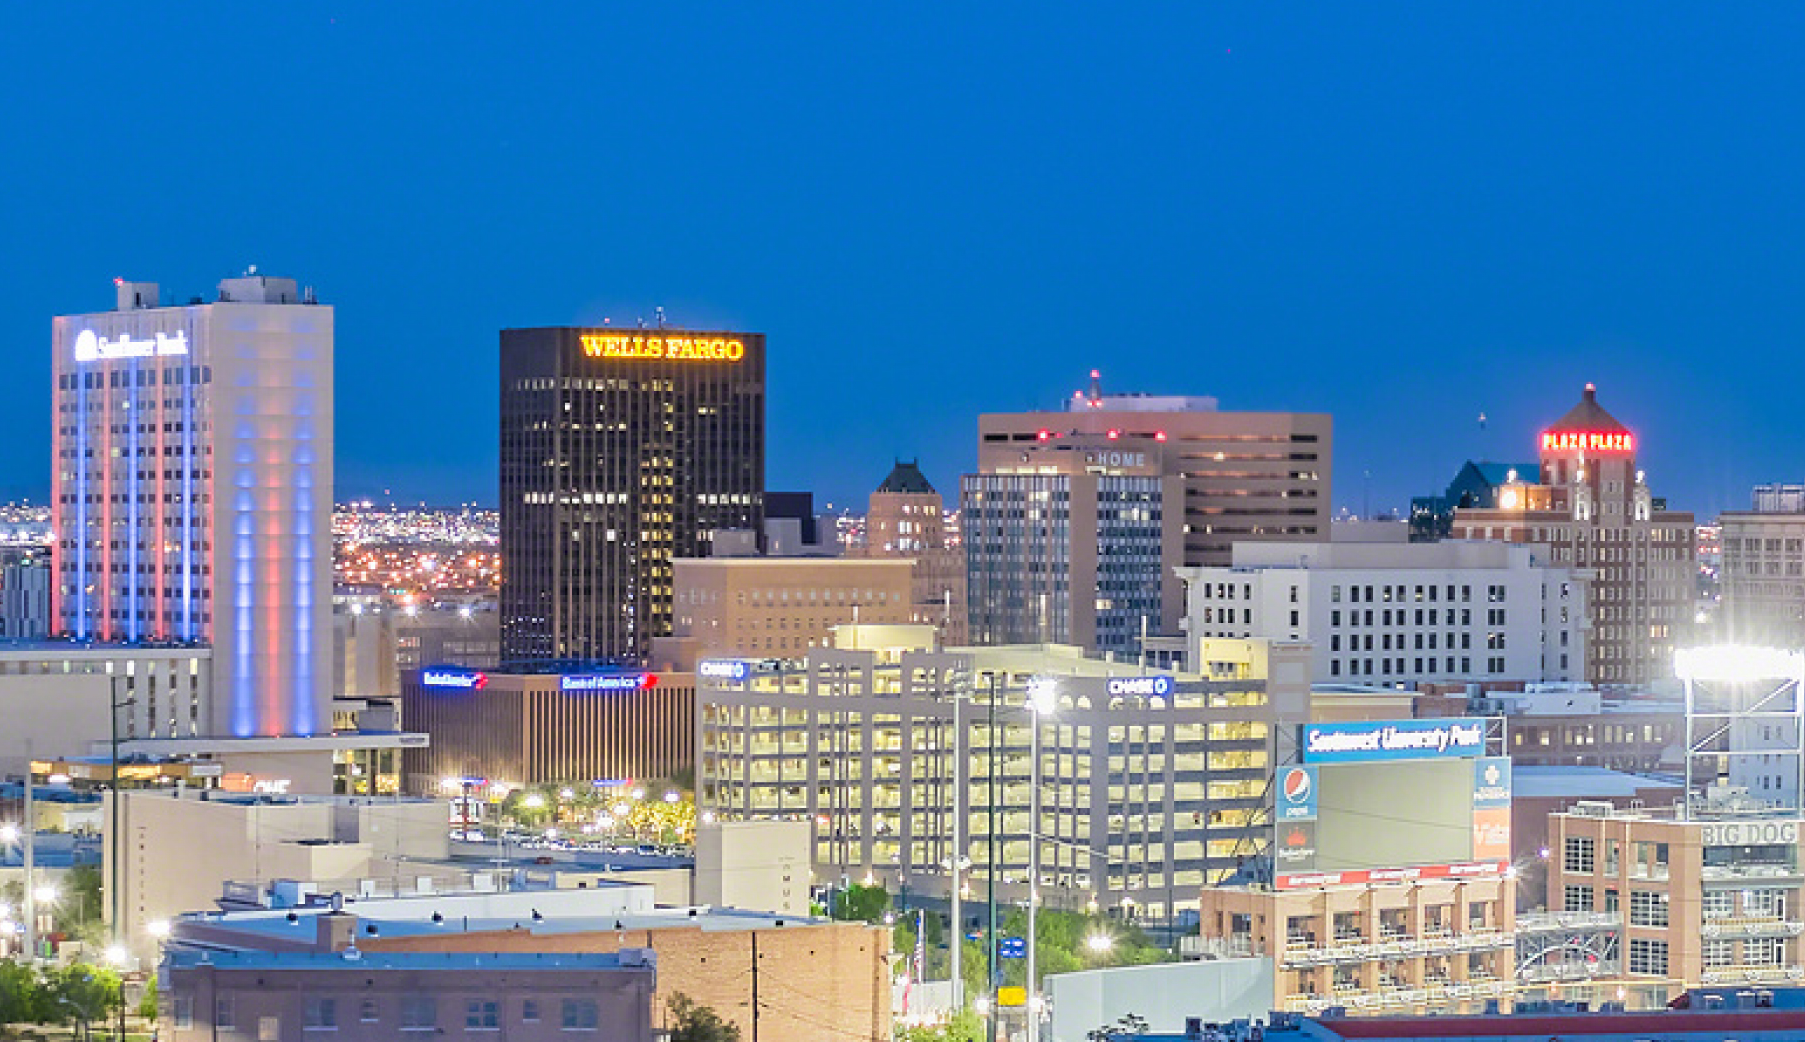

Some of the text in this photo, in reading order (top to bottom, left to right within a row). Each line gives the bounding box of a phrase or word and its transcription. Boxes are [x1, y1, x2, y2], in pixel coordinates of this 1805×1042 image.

[579, 334, 744, 361] WELLS FARGO
[1542, 433, 1632, 451] PLAZA PLAZA
[1097, 451, 1145, 467] HOME
[1702, 825, 1740, 844] BIG
[1745, 822, 1795, 843] DOG
